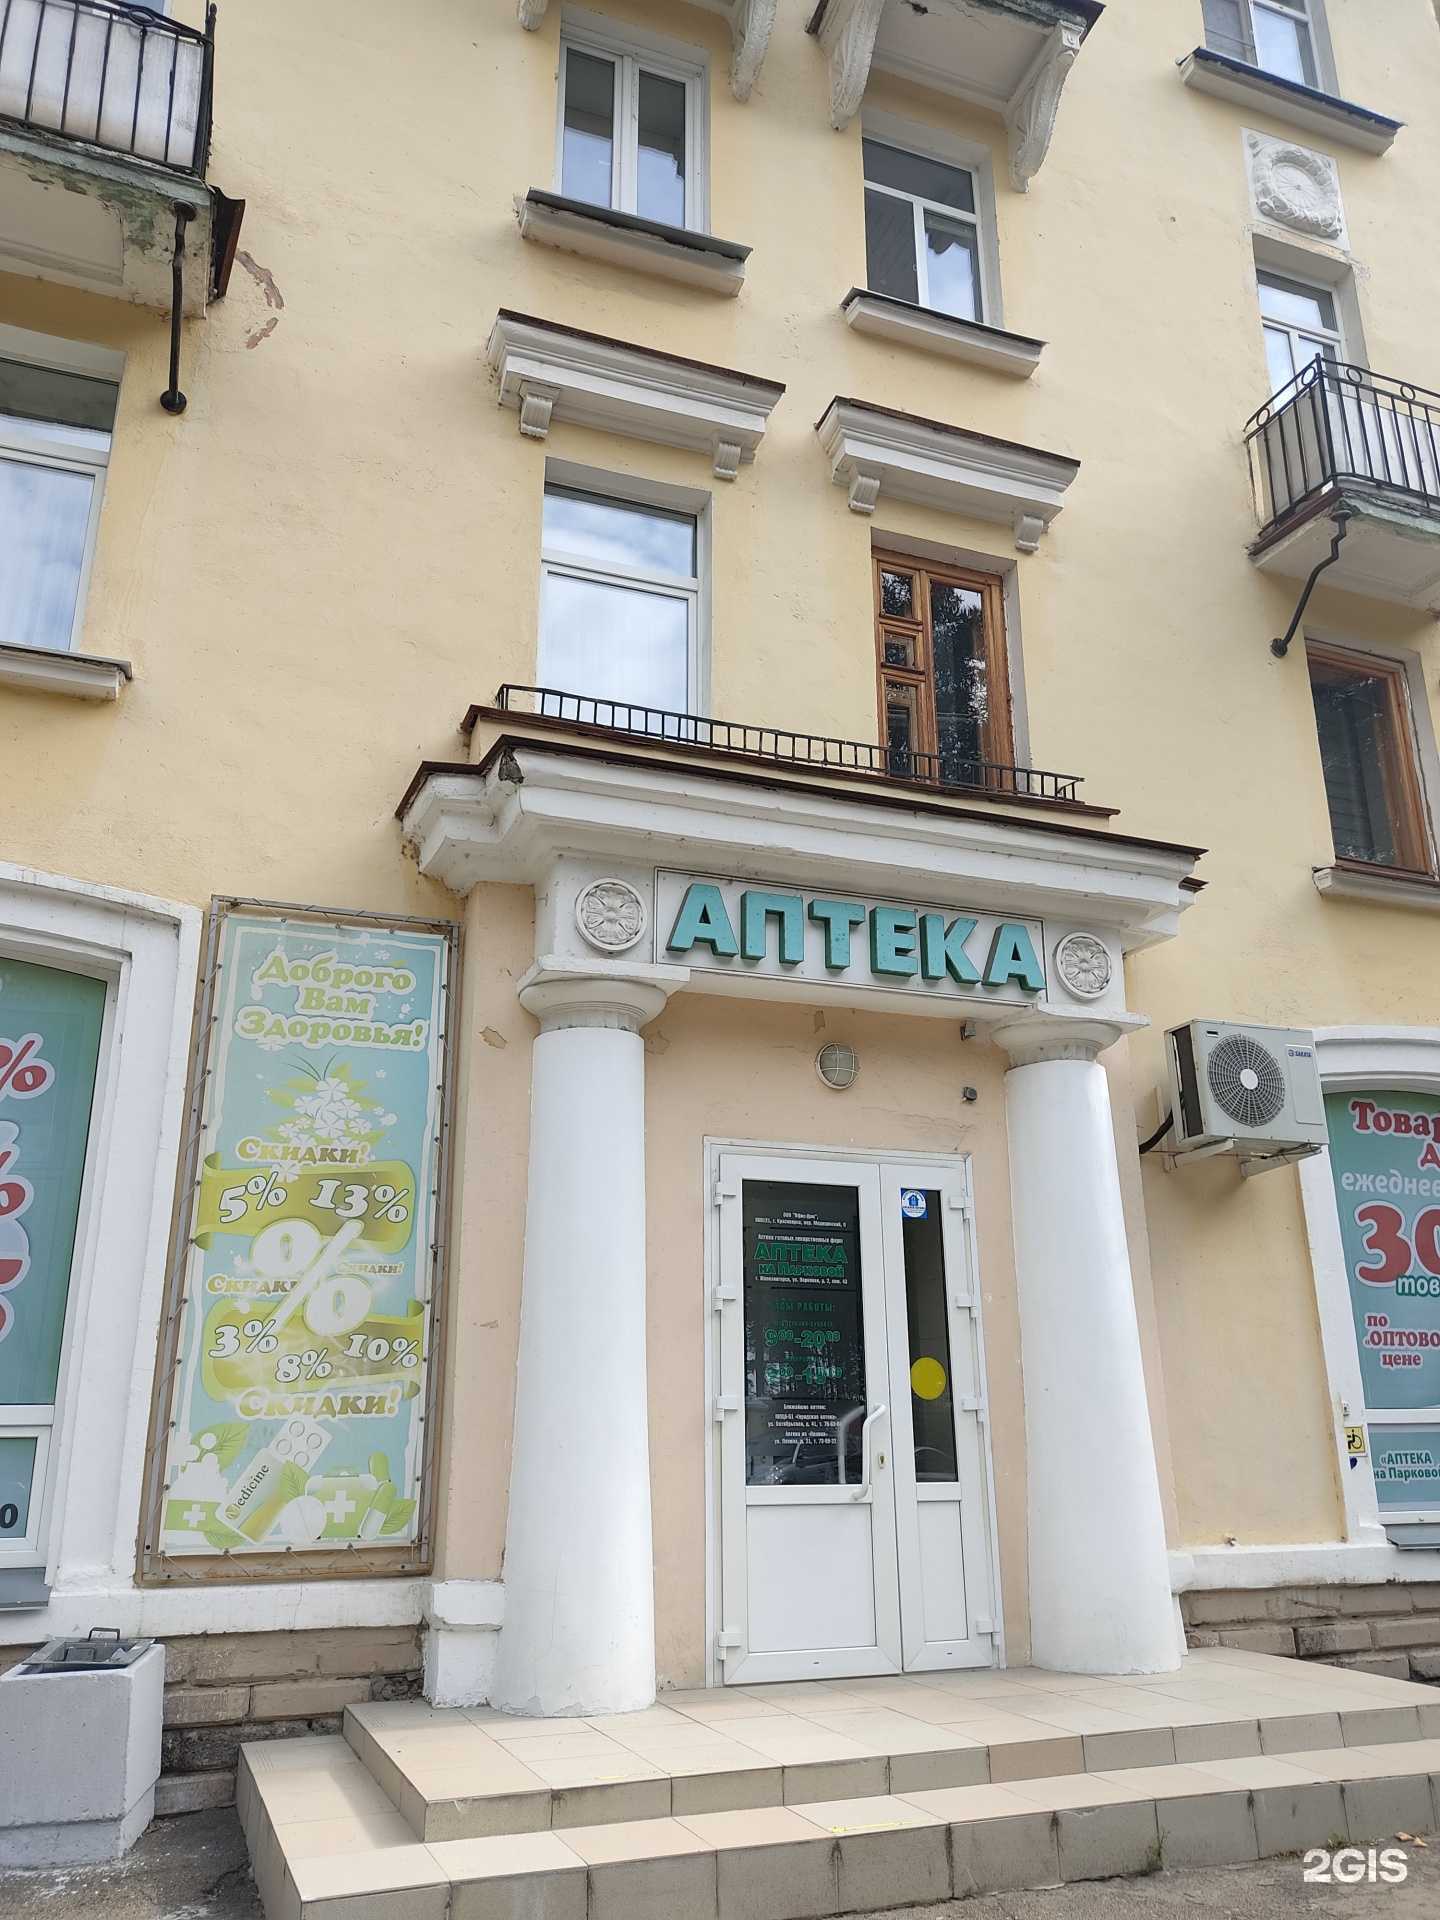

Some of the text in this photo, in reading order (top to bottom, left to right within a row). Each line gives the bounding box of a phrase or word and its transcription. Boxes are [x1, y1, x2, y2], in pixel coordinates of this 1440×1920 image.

[665, 883, 1046, 993] АПТЕКА
[257, 954, 412, 990] Доброго
[300, 986, 370, 1014] Вам
[240, 1010, 425, 1047] Здоровья!
[238, 1138, 369, 1164] Скидки!
[219, 1171, 410, 1224] 5% 13%
[754, 1242, 847, 1263] АПТЕКА
[1367, 1315, 1388, 1327] по
[208, 1319, 419, 1383] 3% 8% 10%
[1382, 1353, 1421, 1367] цене
[238, 1386, 402, 1418] Скидки!
[225, 1463, 270, 1521] Medicine
